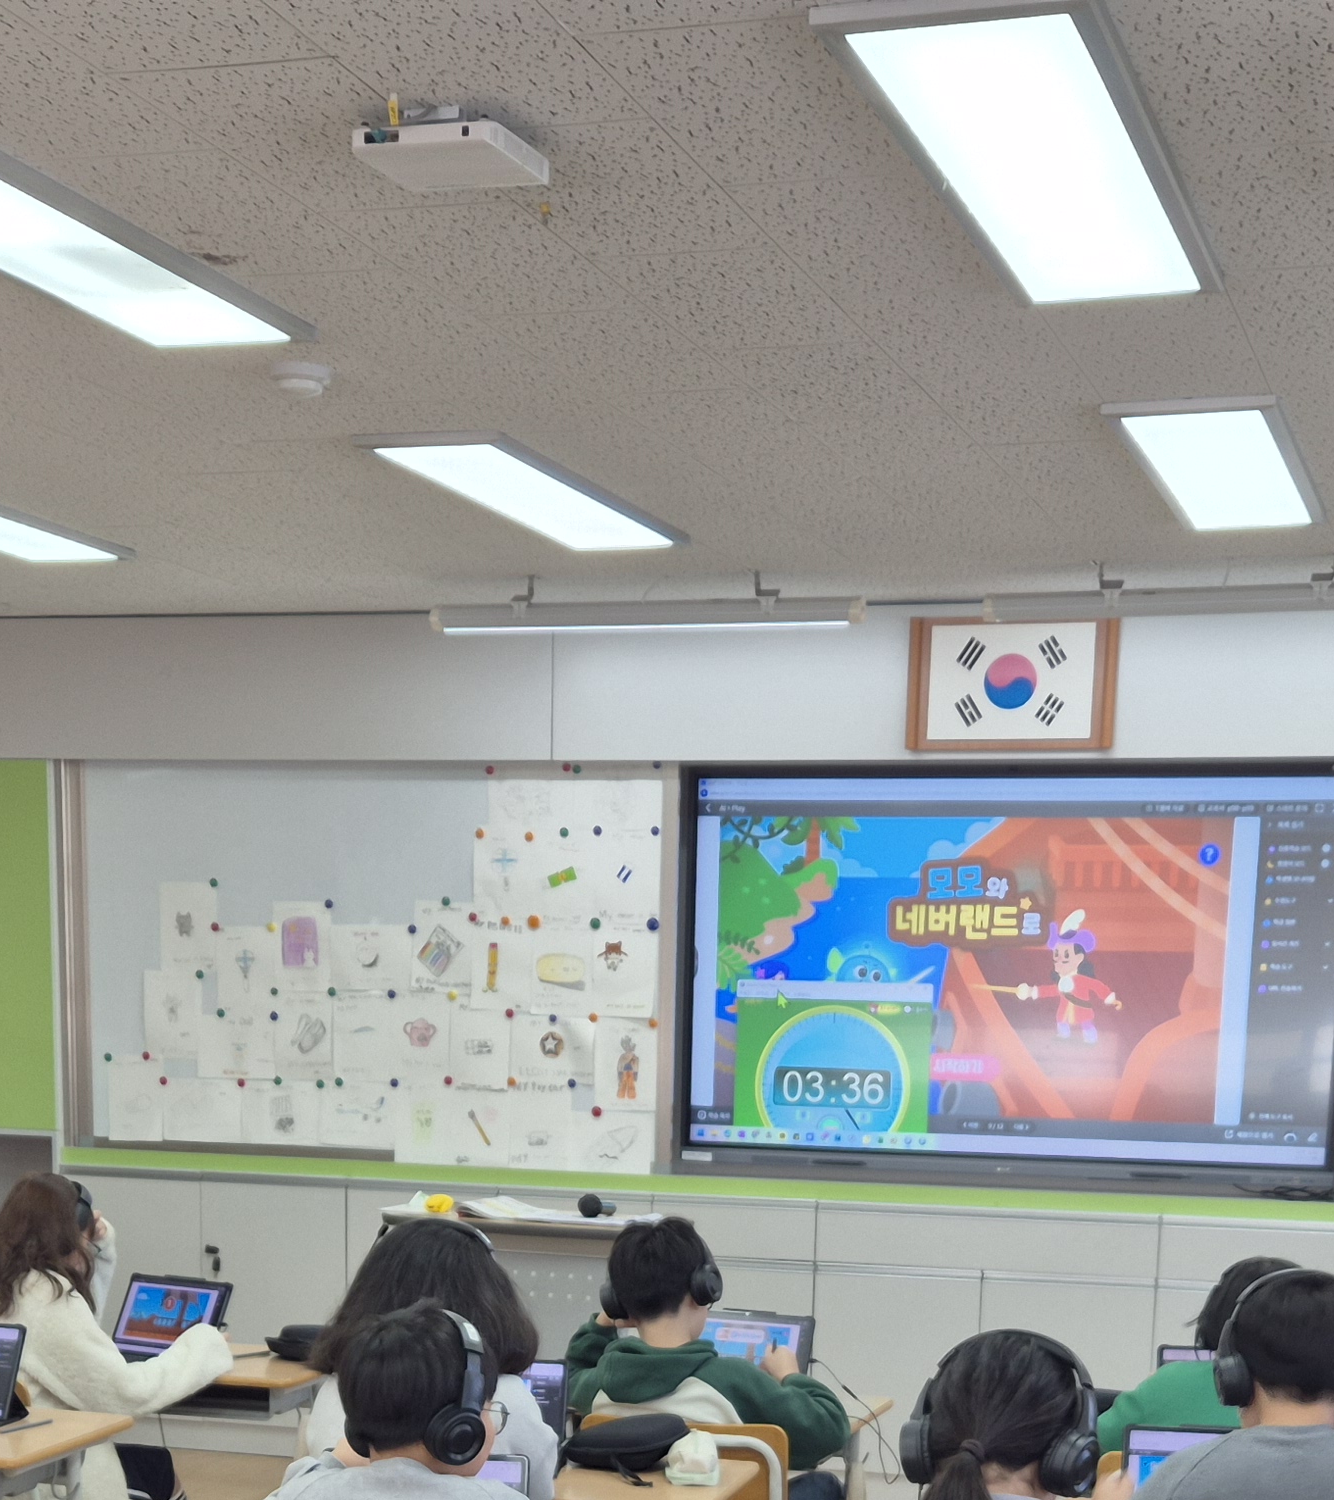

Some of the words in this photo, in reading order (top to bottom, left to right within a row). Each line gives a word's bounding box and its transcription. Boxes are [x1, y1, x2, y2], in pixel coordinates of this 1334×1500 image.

[926, 865, 1009, 899] 모모와
[895, 903, 1042, 940] 네버랜드로
[782, 1069, 886, 1106] 03:36
